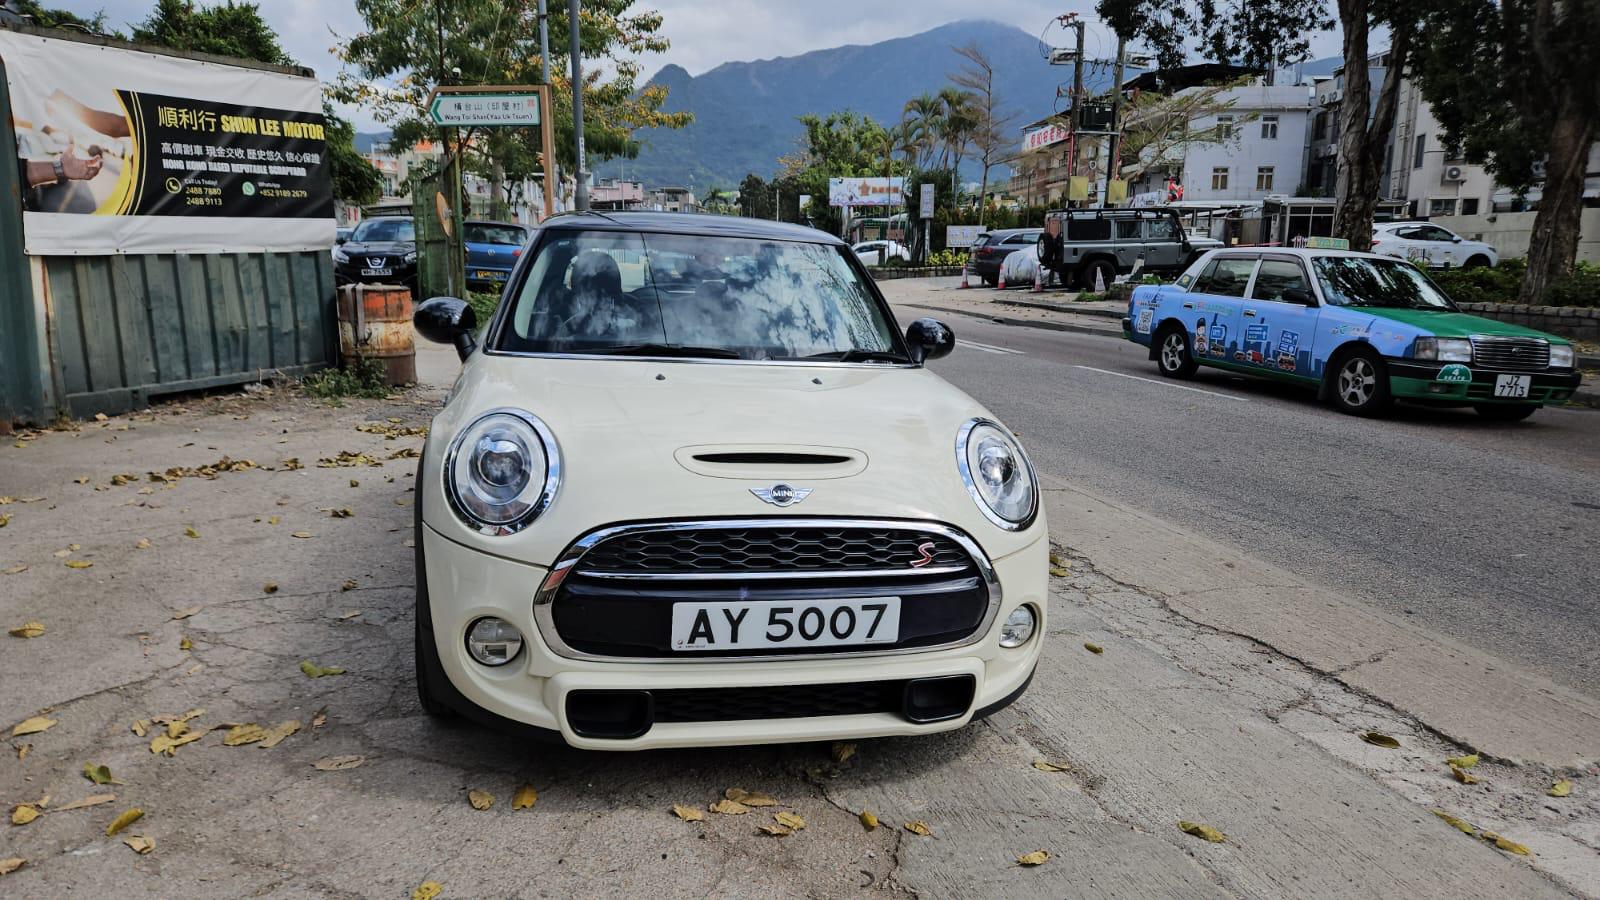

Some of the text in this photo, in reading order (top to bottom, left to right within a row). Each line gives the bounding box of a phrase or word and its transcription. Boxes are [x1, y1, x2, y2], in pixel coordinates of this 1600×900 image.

[158, 106, 217, 132] 順利行
[444, 113, 461, 121] Wang
[220, 114, 325, 140] SHUN LEE MOTOR
[205, 145, 245, 159] 現金交收
[205, 197, 223, 206] 9113
[1451, 368, 1460, 377] 4
[1505, 375, 1521, 386] JZ
[1499, 385, 1525, 397] 7713
[772, 489, 794, 498] MINI
[909, 541, 936, 568] S
[687, 603, 888, 644] AY 5007
